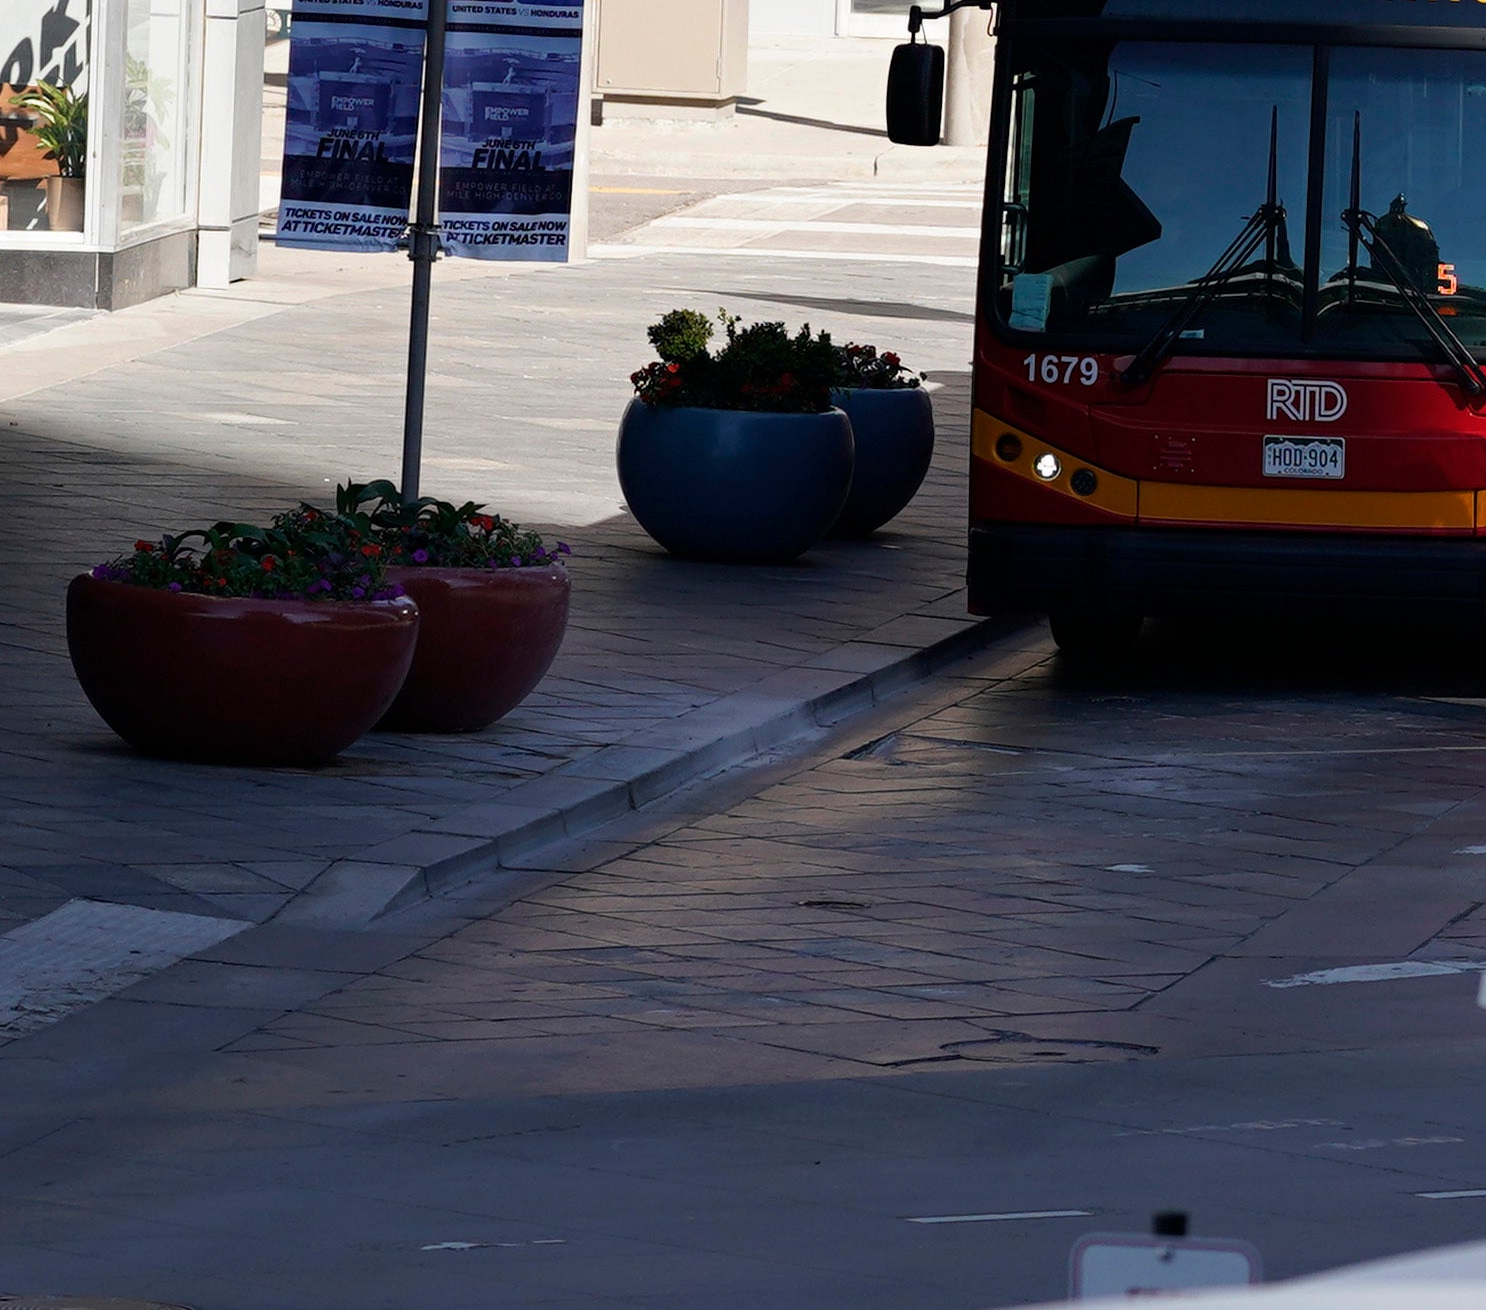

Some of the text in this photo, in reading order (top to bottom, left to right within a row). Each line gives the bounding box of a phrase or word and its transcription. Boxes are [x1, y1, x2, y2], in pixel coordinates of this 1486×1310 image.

[452, 5, 483, 15] UNITED
[484, 6, 517, 16] STATES
[530, 8, 579, 19] HONDURAS
[331, 96, 375, 107] EMPOWER
[485, 106, 529, 117] EMPOWER
[327, 129, 381, 141] JUNE 6TH
[316, 137, 391, 162] FINAL
[482, 140, 536, 151] JUNE 6TH
[471, 149, 546, 172] FINAL
[300, 169, 352, 181] EMPOWER
[455, 182, 508, 192] EMPOWER
[285, 207, 331, 220] TICKETS
[333, 210, 349, 220] ON
[351, 211, 380, 224] SALE
[281, 220, 302, 231] AT
[443, 220, 566, 232] TICKETS ON SALE NOW
[460, 233, 566, 246] TICKETMASTER
[1437, 263, 1457, 295] 5
[1023, 353, 1099, 386] 1679
[1266, 378, 1348, 422] RTD
[1283, 467, 1324, 475] COLORADO
